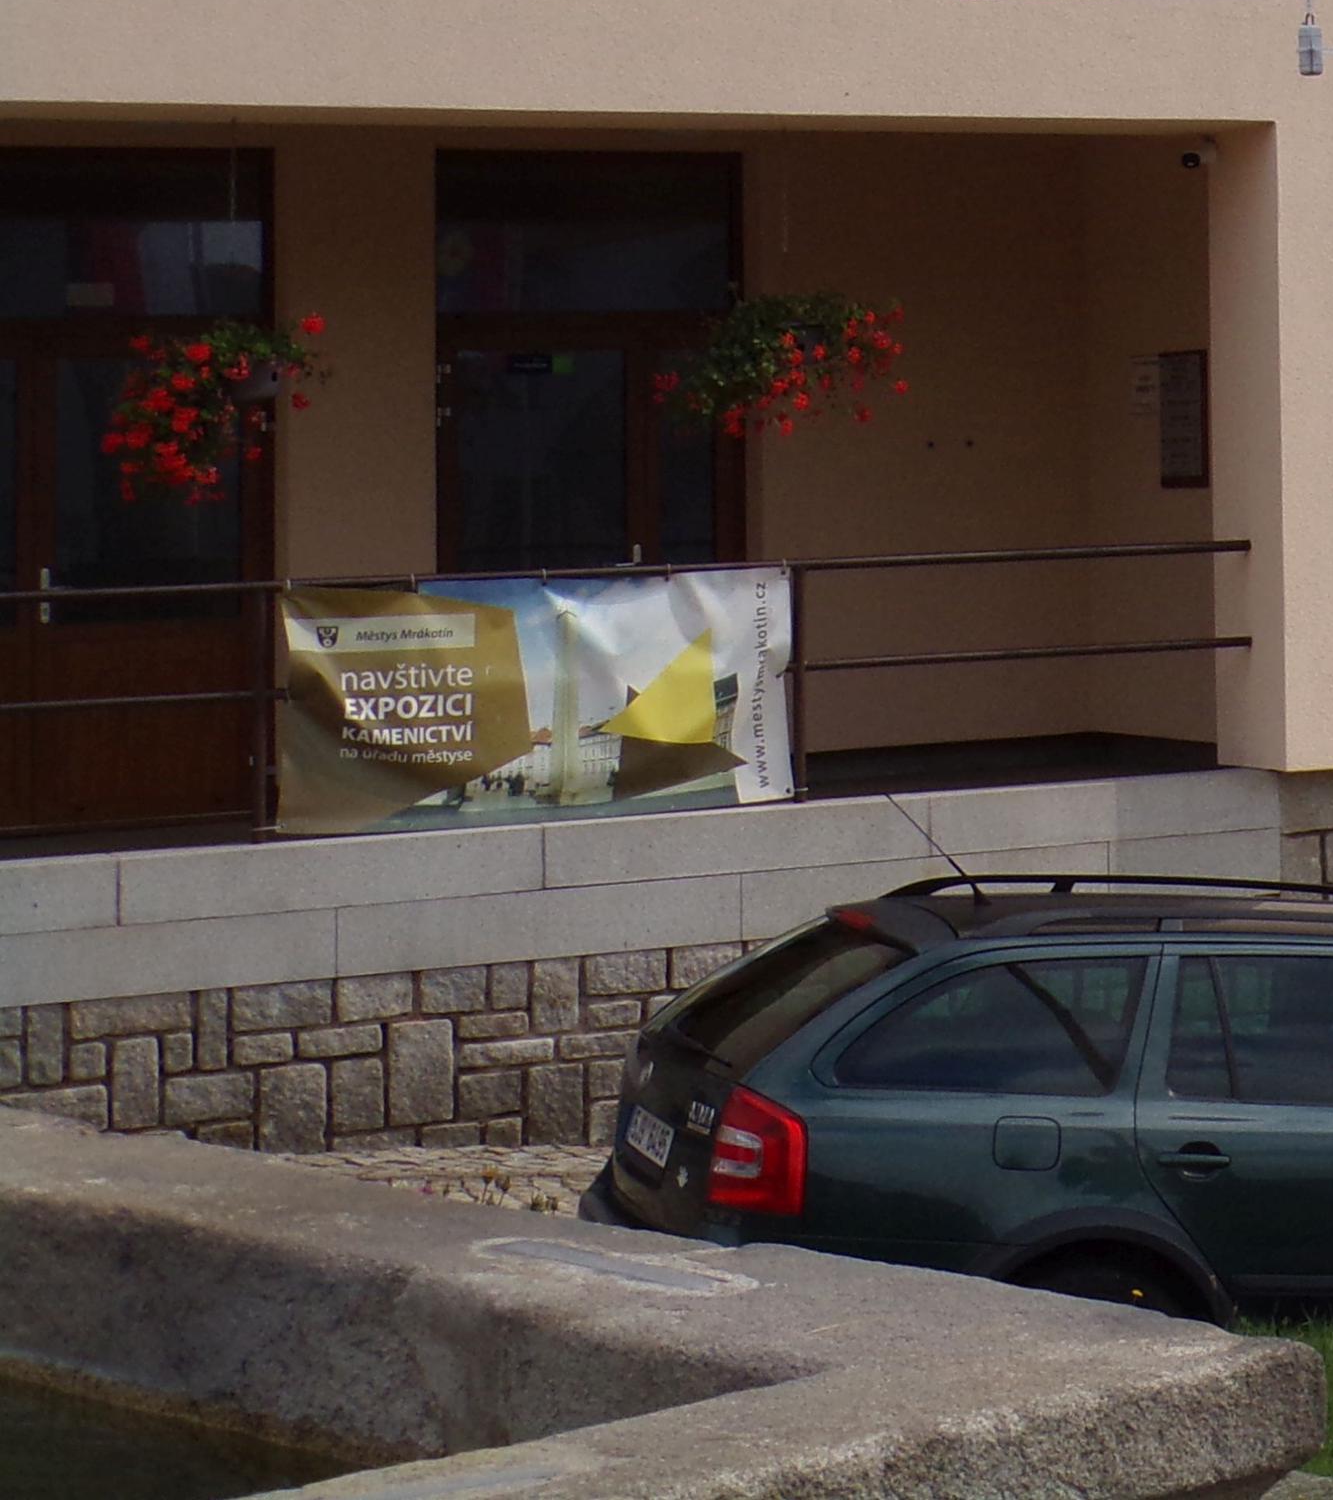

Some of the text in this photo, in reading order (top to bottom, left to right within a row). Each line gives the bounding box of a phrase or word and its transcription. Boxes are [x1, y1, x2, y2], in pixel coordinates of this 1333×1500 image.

[355, 627, 454, 642] Městys Mrákotín
[340, 663, 474, 691] navštivte
[344, 693, 473, 721] EXPOZICI
[341, 721, 473, 745] KAMENICTVÍ
[339, 748, 358, 759] na
[411, 749, 473, 766] městyse
